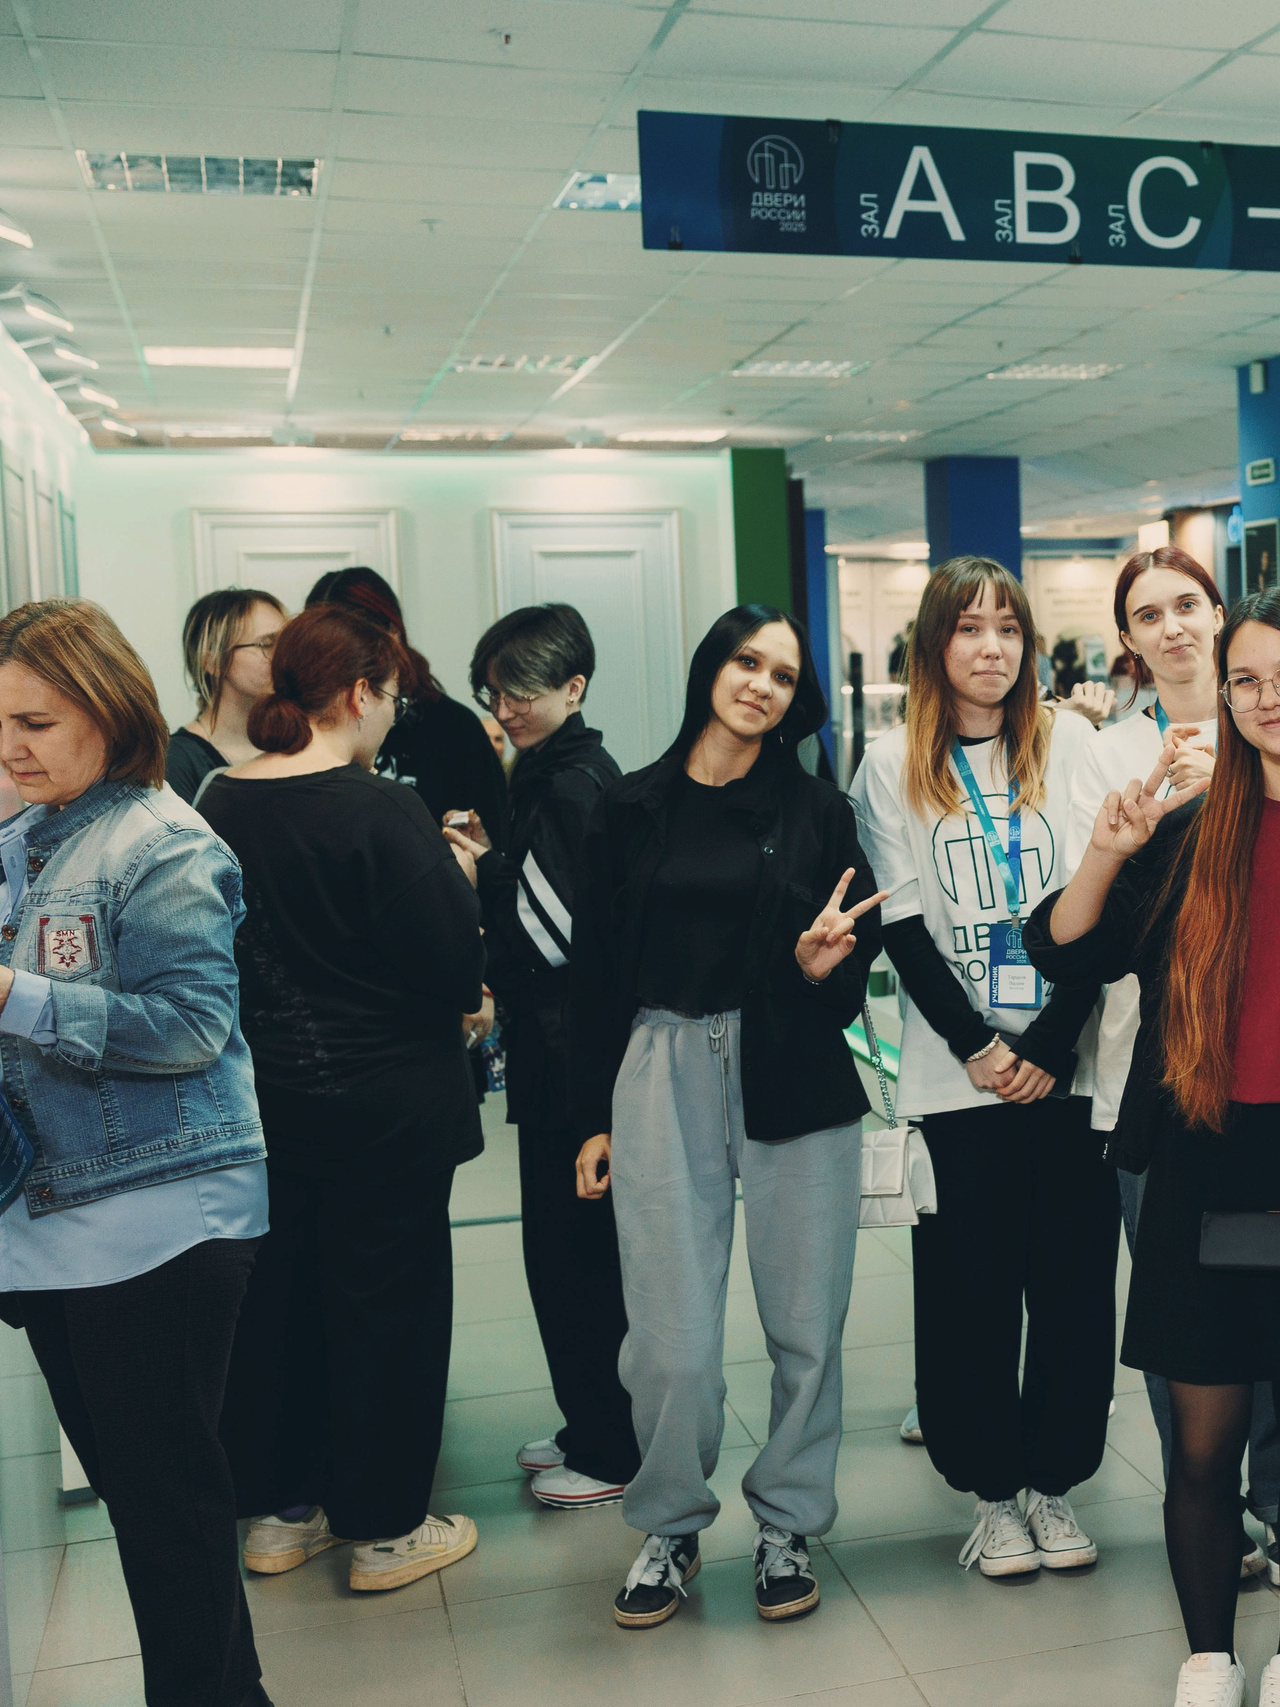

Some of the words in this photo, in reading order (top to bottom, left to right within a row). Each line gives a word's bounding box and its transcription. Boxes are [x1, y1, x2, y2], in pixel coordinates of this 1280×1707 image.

[750, 207, 807, 221] РОССИИ
[751, 191, 806, 208] ДВЕРИ
[859, 193, 880, 239] ЗАЛ
[882, 145, 966, 241] A
[994, 199, 1014, 243] ЗАЛ
[1013, 151, 1081, 245] B
[1107, 204, 1127, 248] ЗАЛ
[1127, 155, 1202, 249] C
[56, 929, 75, 937] SMN
